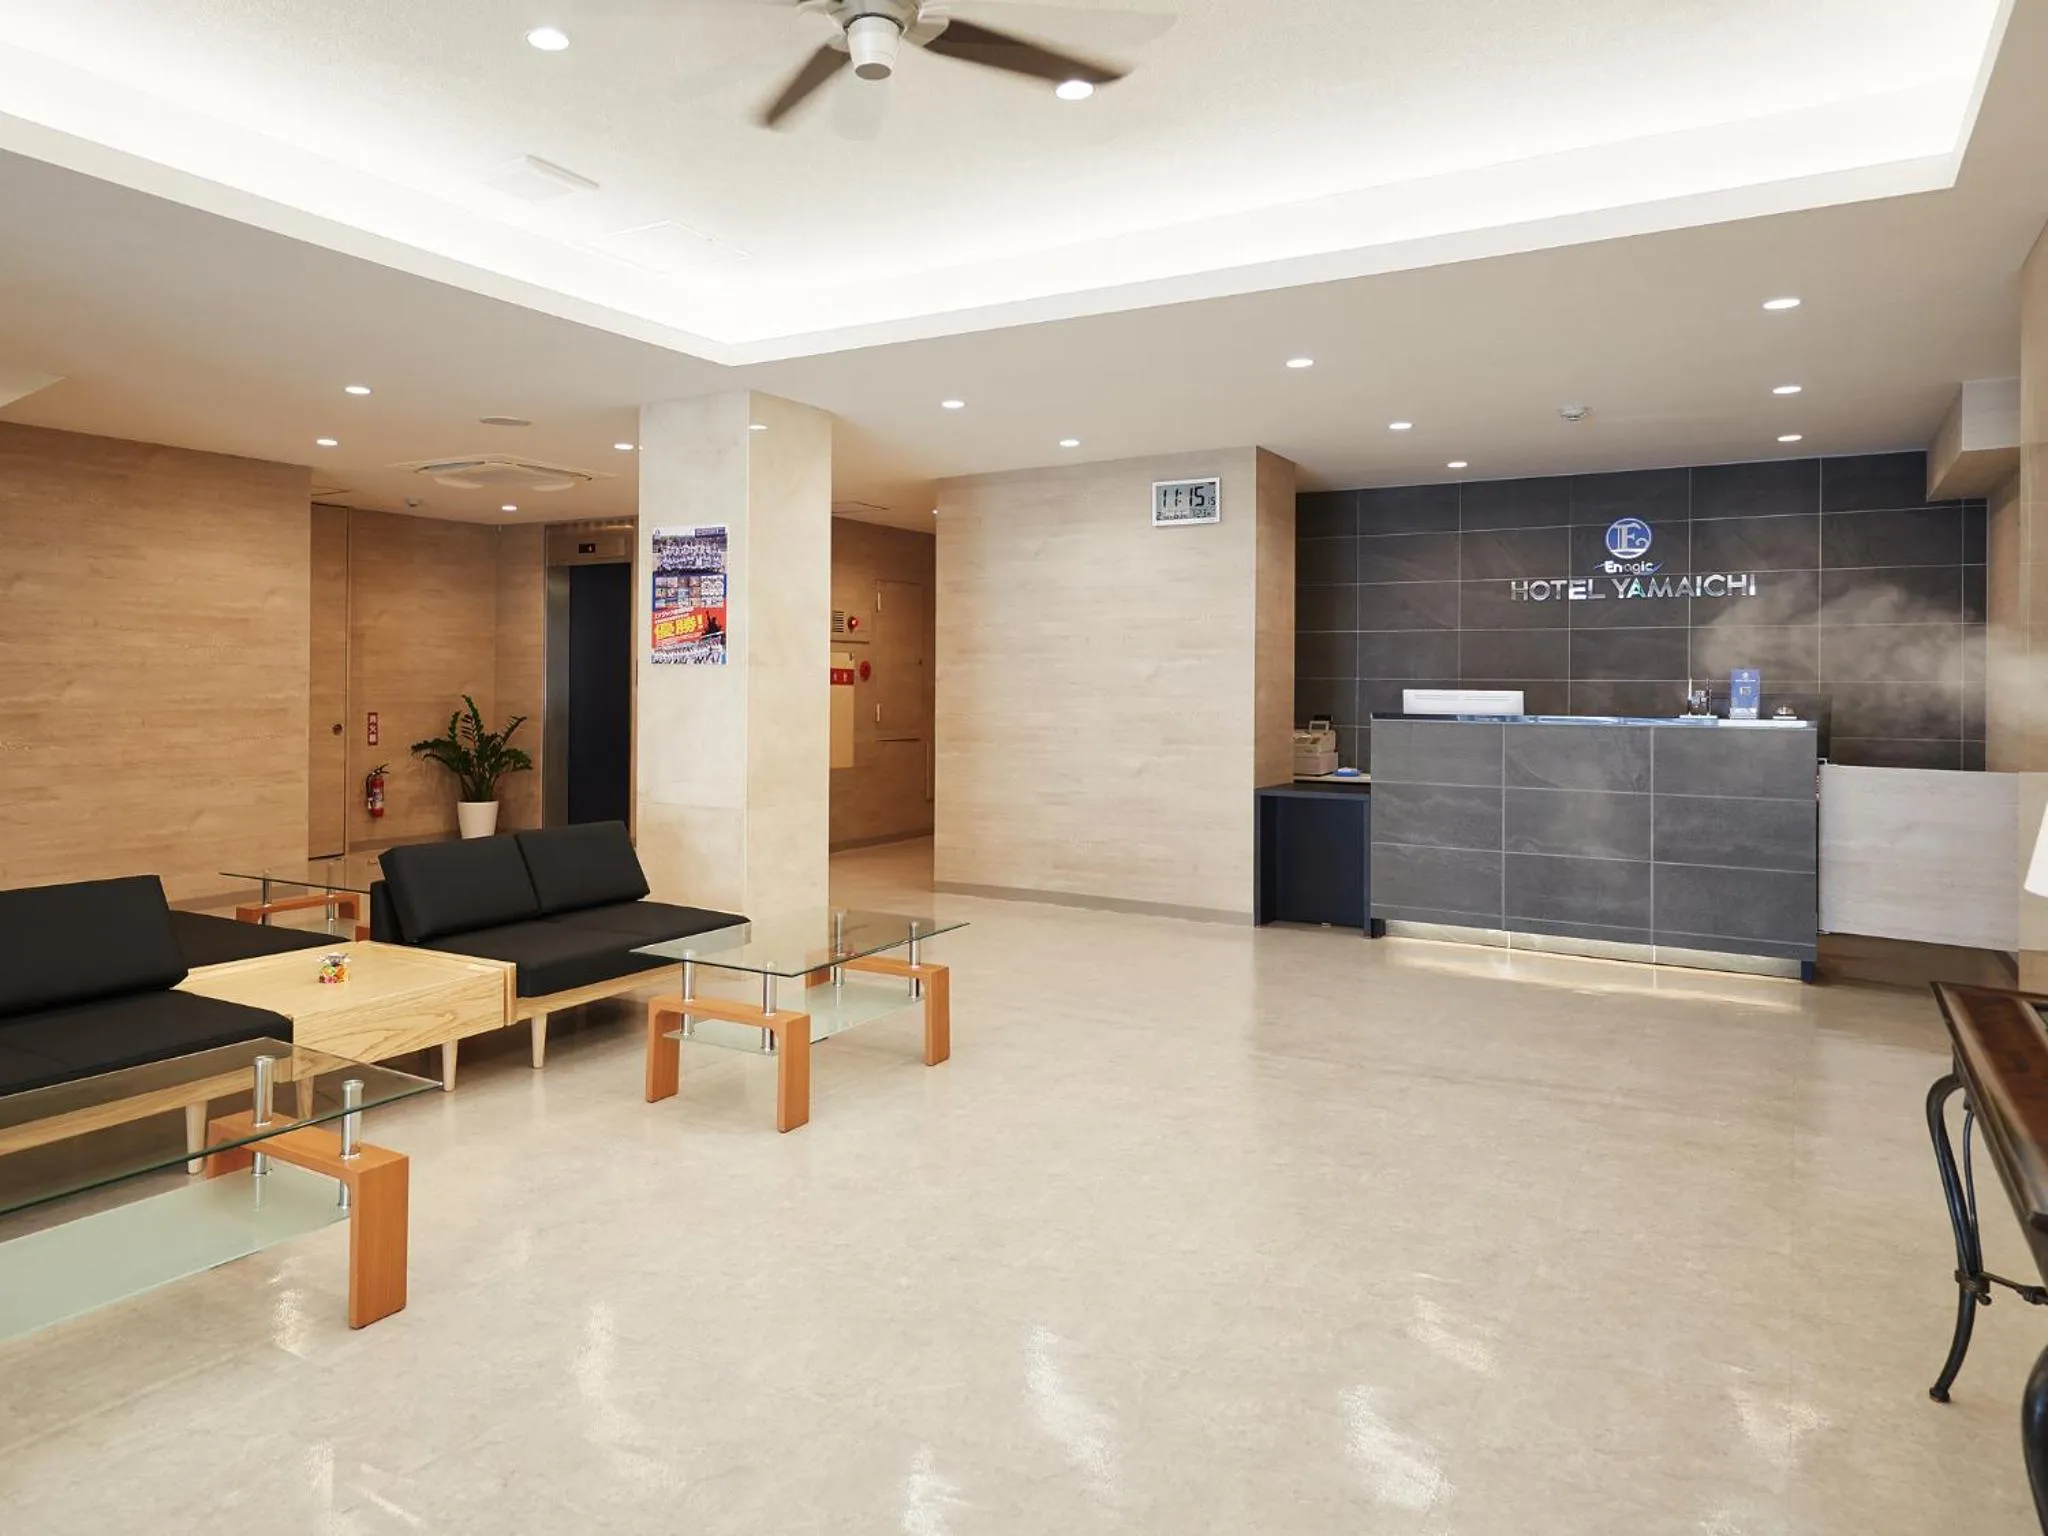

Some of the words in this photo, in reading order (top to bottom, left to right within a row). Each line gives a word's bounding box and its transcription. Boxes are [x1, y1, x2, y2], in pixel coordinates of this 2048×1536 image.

[1163, 485, 1205, 507] 11:15
[1510, 578, 1606, 601] HOTEL
[1611, 574, 1757, 599] YAMAICHI
